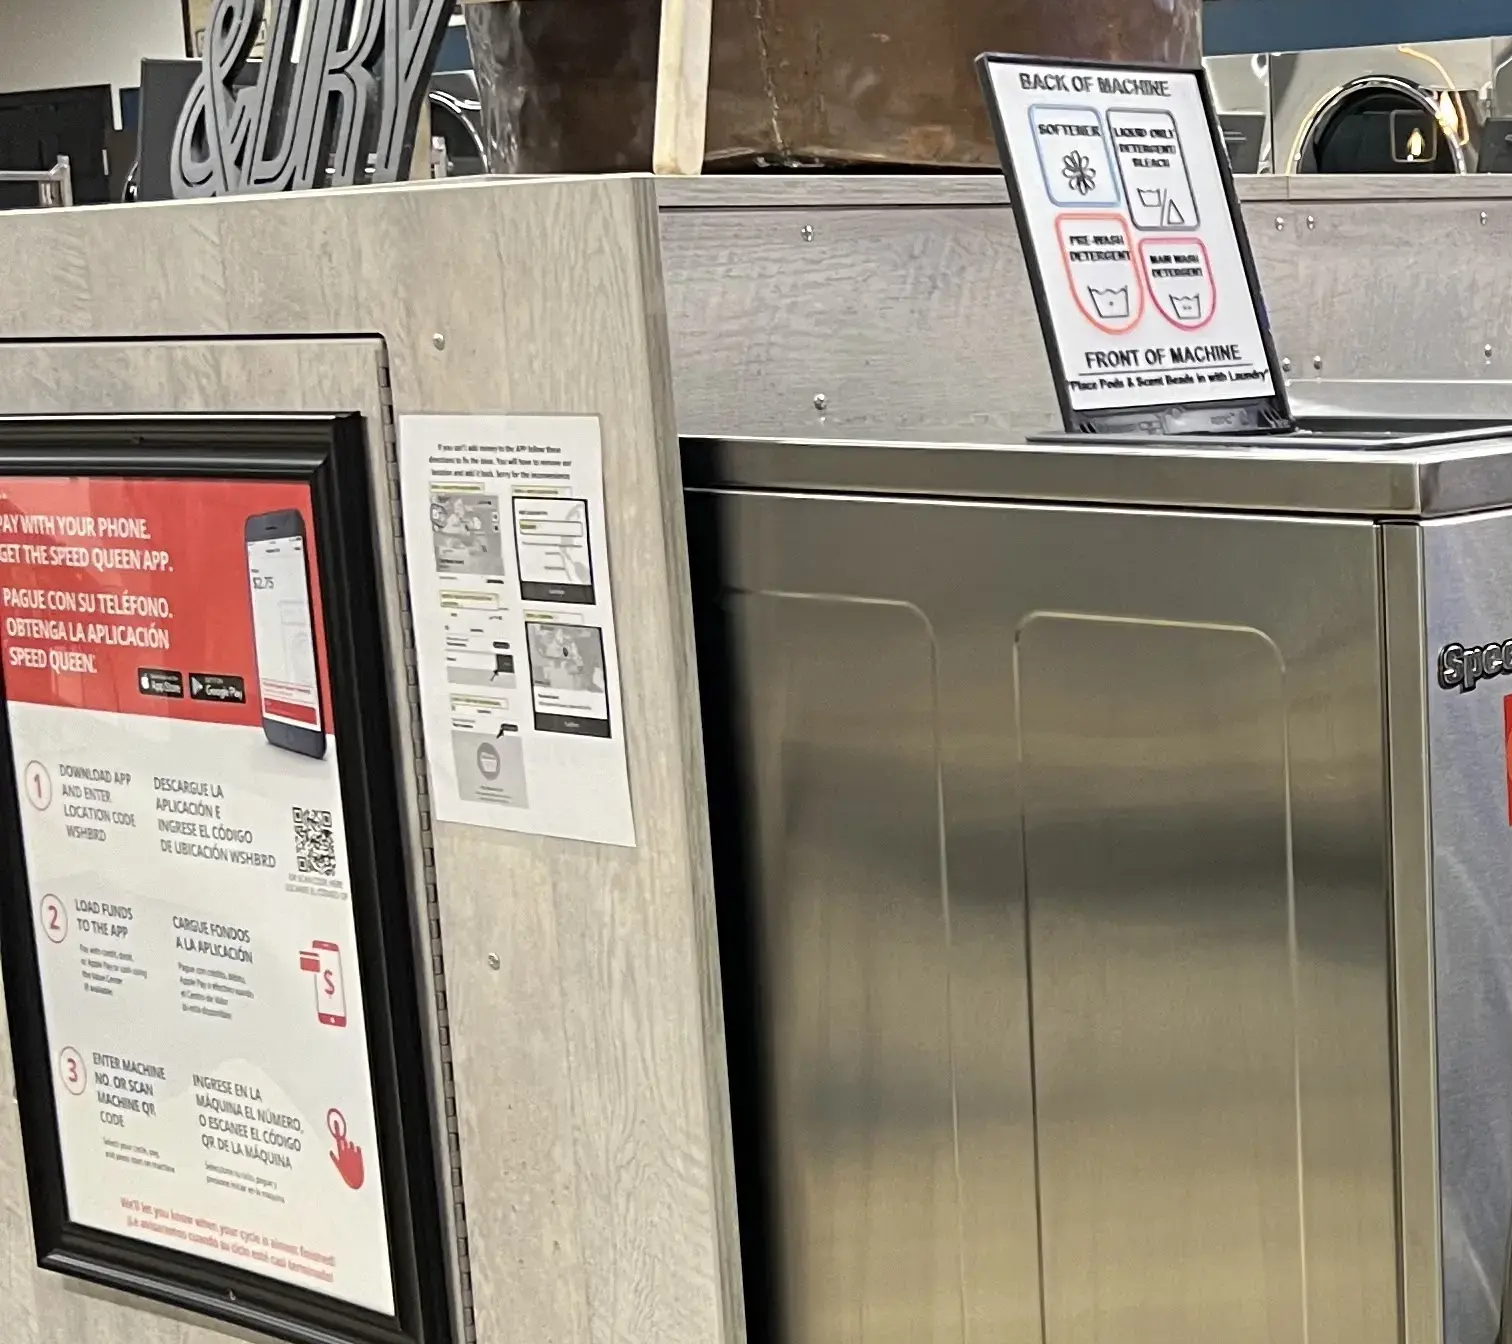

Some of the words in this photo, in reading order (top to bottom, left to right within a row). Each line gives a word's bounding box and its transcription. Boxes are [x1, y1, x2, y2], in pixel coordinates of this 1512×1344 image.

[1019, 73, 1069, 91] BACK
[1072, 76, 1094, 92] OF
[1097, 77, 1171, 97] MACHINE
[1038, 124, 1100, 136] SOFTENER
[1114, 128, 1147, 138] LIQUID
[1132, 158, 1170, 167] BLEACH
[1069, 235, 1124, 245] PRE-WASH
[1069, 251, 1130, 262] DETERGENT
[1152, 268, 1202, 278] DETERGENT
[1085, 349, 1139, 368] FRONT
[1145, 348, 1165, 365] OF
[1169, 344, 1242, 363] MACHINE
[21, 515, 54, 536] WITH
[57, 516, 96, 537] YOUR
[99, 517, 151, 539] PHONE.
[0, 544, 21, 563] GET
[23, 545, 49, 564] THE
[51, 547, 89, 567] SPEED
[92, 548, 141, 572] QUEEN
[143, 551, 173, 571] APP.
[253, 577, 274, 589] $2.75
[3, 588, 46, 609] PAGUE
[48, 591, 76, 611] CON
[78, 593, 95, 612] SU
[97, 590, 173, 618] TELÉFONO.
[7, 618, 67, 641] OBTENGA
[69, 622, 86, 642] LA
[88, 622, 169, 649] APLICACIÓN
[9, 647, 47, 668] SPEED
[206, 685, 227, 698] Google
[228, 686, 243, 699] Play
[33, 774, 42, 799] 1
[60, 764, 111, 785] DOWNLOAD
[114, 771, 131, 786] APP
[62, 784, 83, 799] AND
[85, 788, 111, 803] ENTER
[154, 777, 208, 797] DESCARGUE
[211, 785, 223, 799] LA
[64, 804, 110, 823] LOCATION
[112, 809, 136, 827] CODE
[156, 797, 213, 818] APLICACIÓN
[215, 805, 221, 819] E
[158, 819, 197, 837] INGRESE
[199, 825, 210, 839] EL
[212, 822, 253, 844] CÓDIGO
[160, 839, 172, 853] DE
[175, 842, 228, 862] UBICACIÓN
[48, 905, 60, 930] 2
[75, 898, 100, 916] LOAD
[102, 902, 133, 921] FUNDS
[77, 918, 89, 933] TO
[90, 920, 109, 936] THE
[111, 923, 128, 939] APP
[173, 916, 208, 935] CARGUE
[210, 924, 250, 943] FONDOS
[176, 936, 183, 950] A
[184, 937, 197, 952] LA
[198, 939, 253, 964] APLICACIÓN
[68, 1058, 78, 1082] 3
[93, 1052, 120, 1071] ENTER
[122, 1058, 166, 1081] MACHINE
[113, 1075, 126, 1091] OR
[128, 1078, 154, 1097] SCAN
[192, 1074, 232, 1097] INGRESE
[233, 1082, 248, 1099] EN
[249, 1087, 262, 1103] LA
[97, 1091, 140, 1114] MACHINE
[142, 1100, 156, 1117] QR
[195, 1093, 243, 1120] MÁQUINA
[245, 1105, 256, 1121] EL
[100, 1111, 125, 1129] CODE
[199, 1114, 206, 1127] O
[208, 1117, 248, 1140] ESCANEE
[250, 1126, 261, 1143] EL
[263, 1128, 302, 1152] CÓDIGO
[201, 1134, 216, 1150] QR
[217, 1137, 229, 1154] DE
[230, 1140, 243, 1157] LA
[244, 1142, 293, 1170] MÁQUINA
